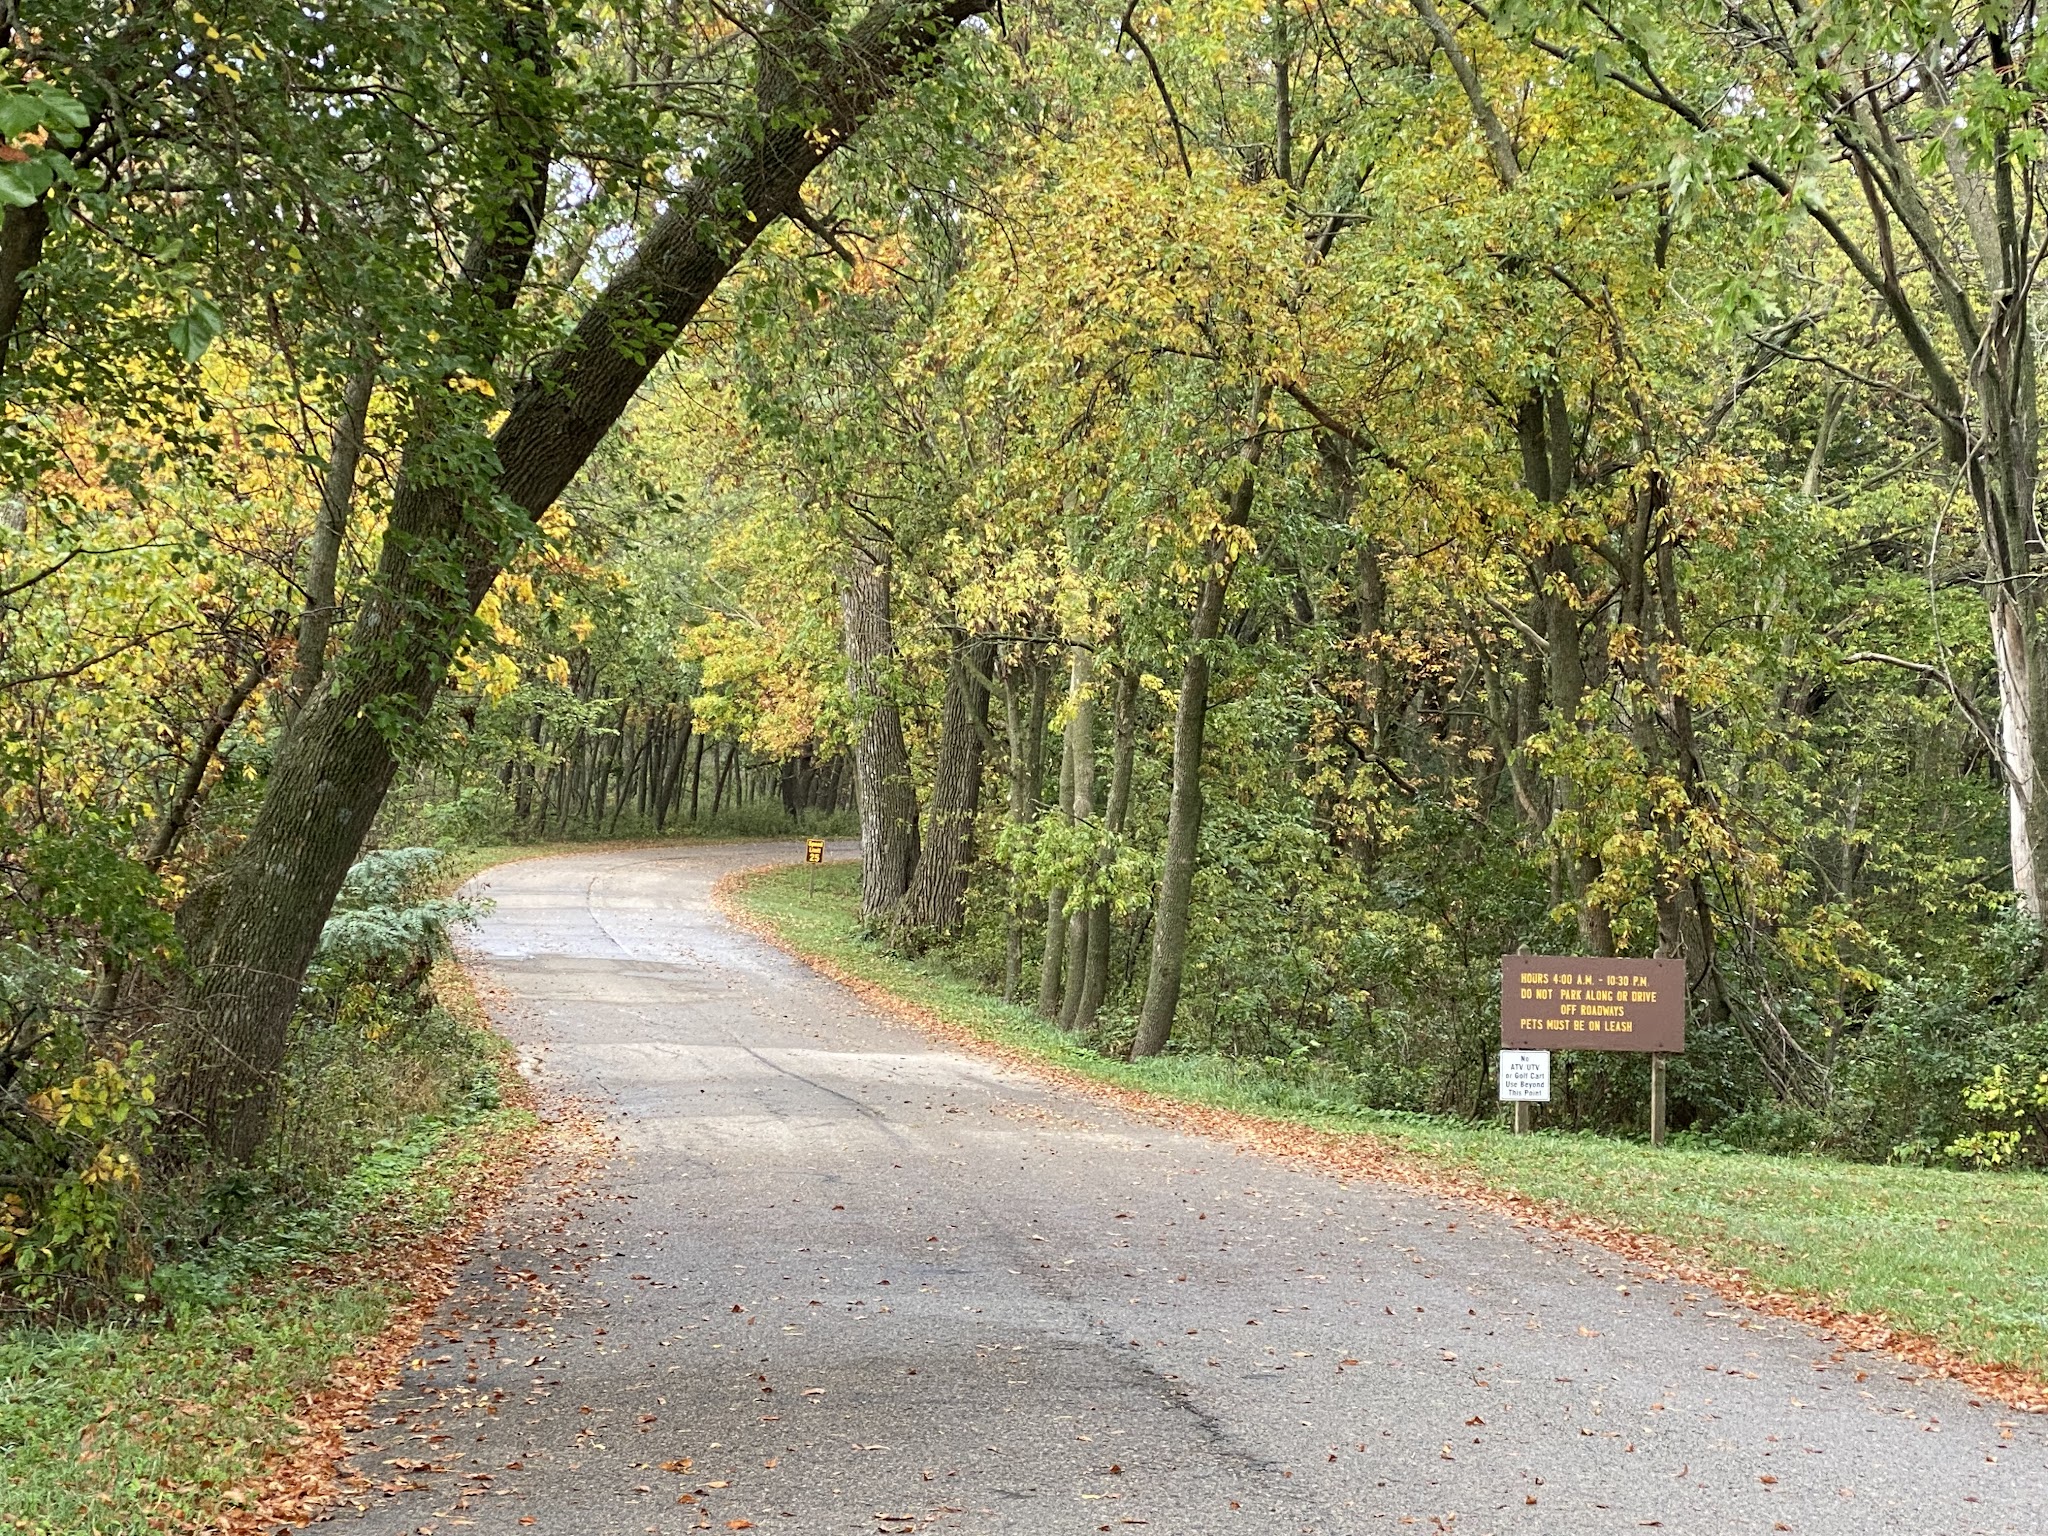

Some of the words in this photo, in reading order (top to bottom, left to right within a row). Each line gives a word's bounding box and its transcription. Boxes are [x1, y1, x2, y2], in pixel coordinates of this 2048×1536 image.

[809, 853, 820, 862] 25
[1520, 973, 1549, 984] HOURS
[1552, 974, 1573, 985] 4:00
[1576, 974, 1595, 986] A.M.
[1606, 975, 1629, 987] 10:30
[1520, 988, 1532, 999] DO
[1535, 989, 1553, 1000] NOT
[1560, 989, 1582, 1001] PARK
[1585, 990, 1614, 1002] ALONG
[1616, 991, 1628, 1002] OR
[1631, 991, 1657, 1003] DRIVE
[1560, 1004, 1577, 1016] OFF
[1580, 1005, 1625, 1017] ROADWAYS
[1520, 1018, 1544, 1030] PETS
[1546, 1019, 1570, 1031] MUST
[1573, 1020, 1585, 1031] BE
[1588, 1020, 1601, 1032] ON
[1604, 1021, 1633, 1033] LEASH
[1530, 1072, 1545, 1080] Cart
[1505, 1080, 1518, 1088] Use
[1520, 1081, 1545, 1089] Beyond
[1524, 1089, 1542, 1097] Point
